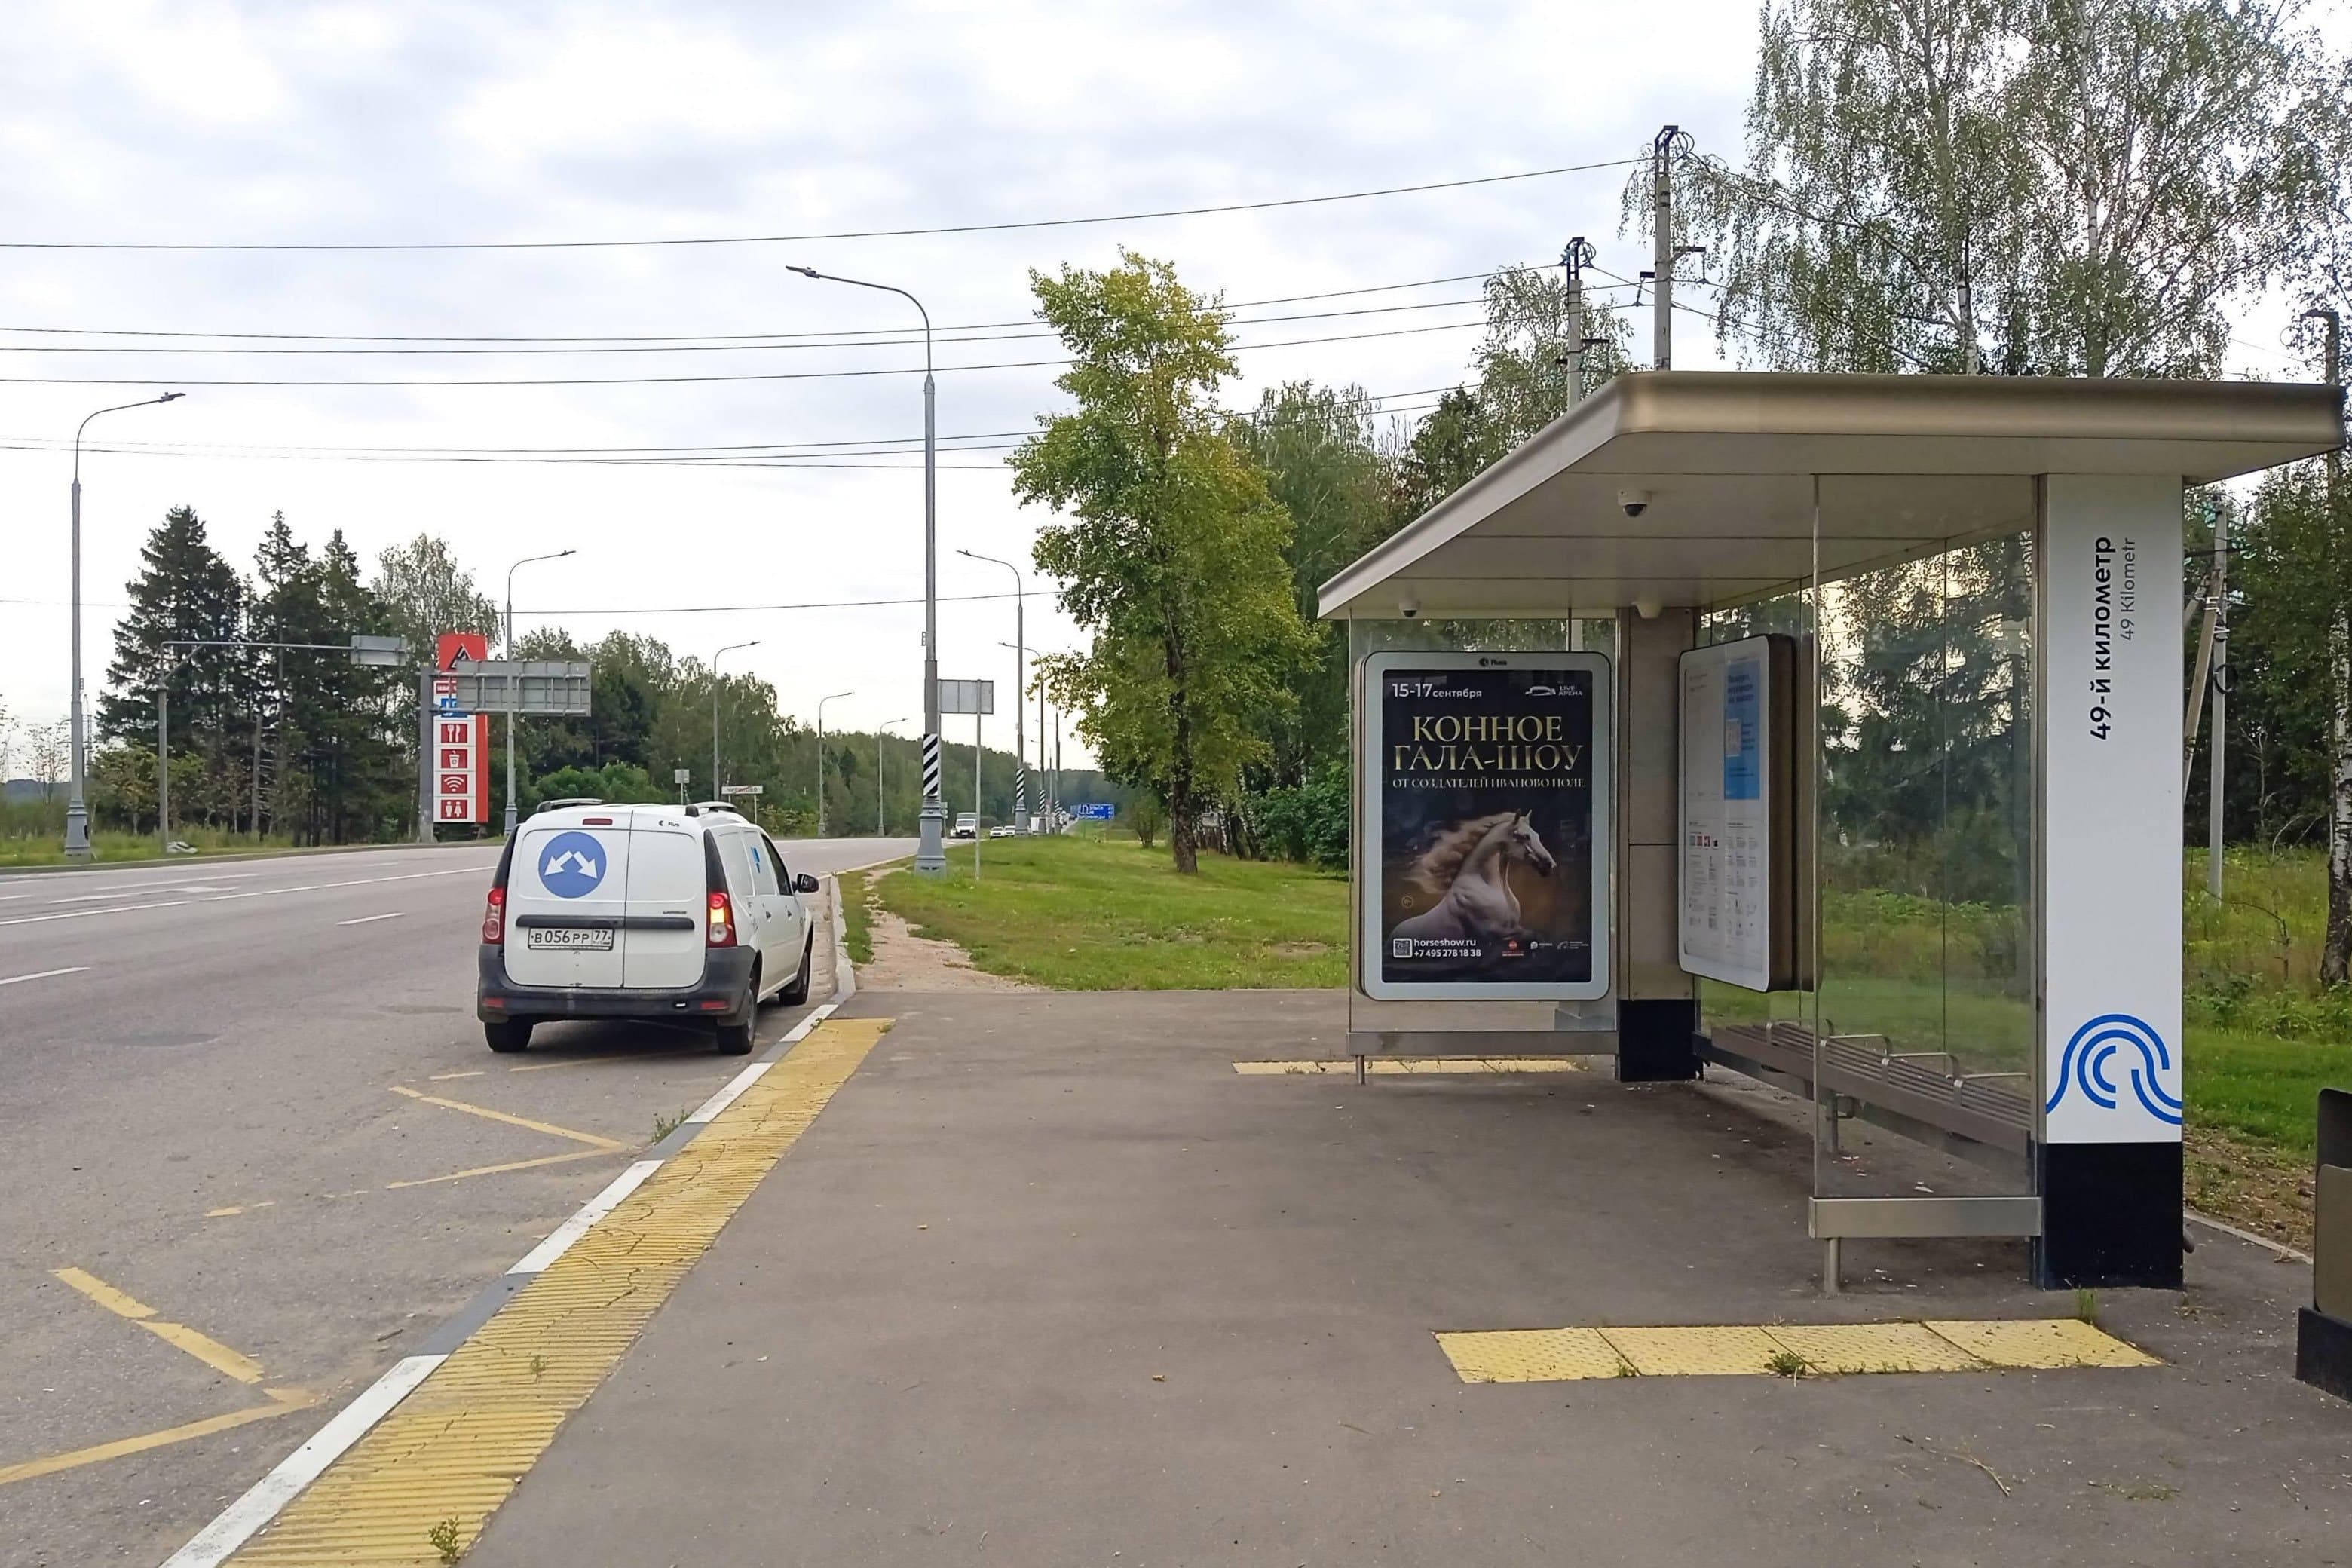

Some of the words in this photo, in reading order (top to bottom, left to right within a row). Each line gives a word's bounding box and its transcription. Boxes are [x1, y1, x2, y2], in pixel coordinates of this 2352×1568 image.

[2119, 537, 2136, 612] Kilometr
[2094, 537, 2116, 671] километр
[2120, 618, 2135, 641] 49
[1392, 683, 1433, 698] 15-17
[1432, 688, 1482, 700] сентября
[2090, 678, 2112, 740] 49-й
[1412, 715, 1563, 742] КОННОЕ
[1393, 744, 1584, 770] ГАЛА-ШОУ
[1392, 778, 1408, 789] ОТ
[1411, 776, 1488, 789] СОЗДАТЕЛЕЙ
[1413, 938, 1477, 947] horseshow.ru
